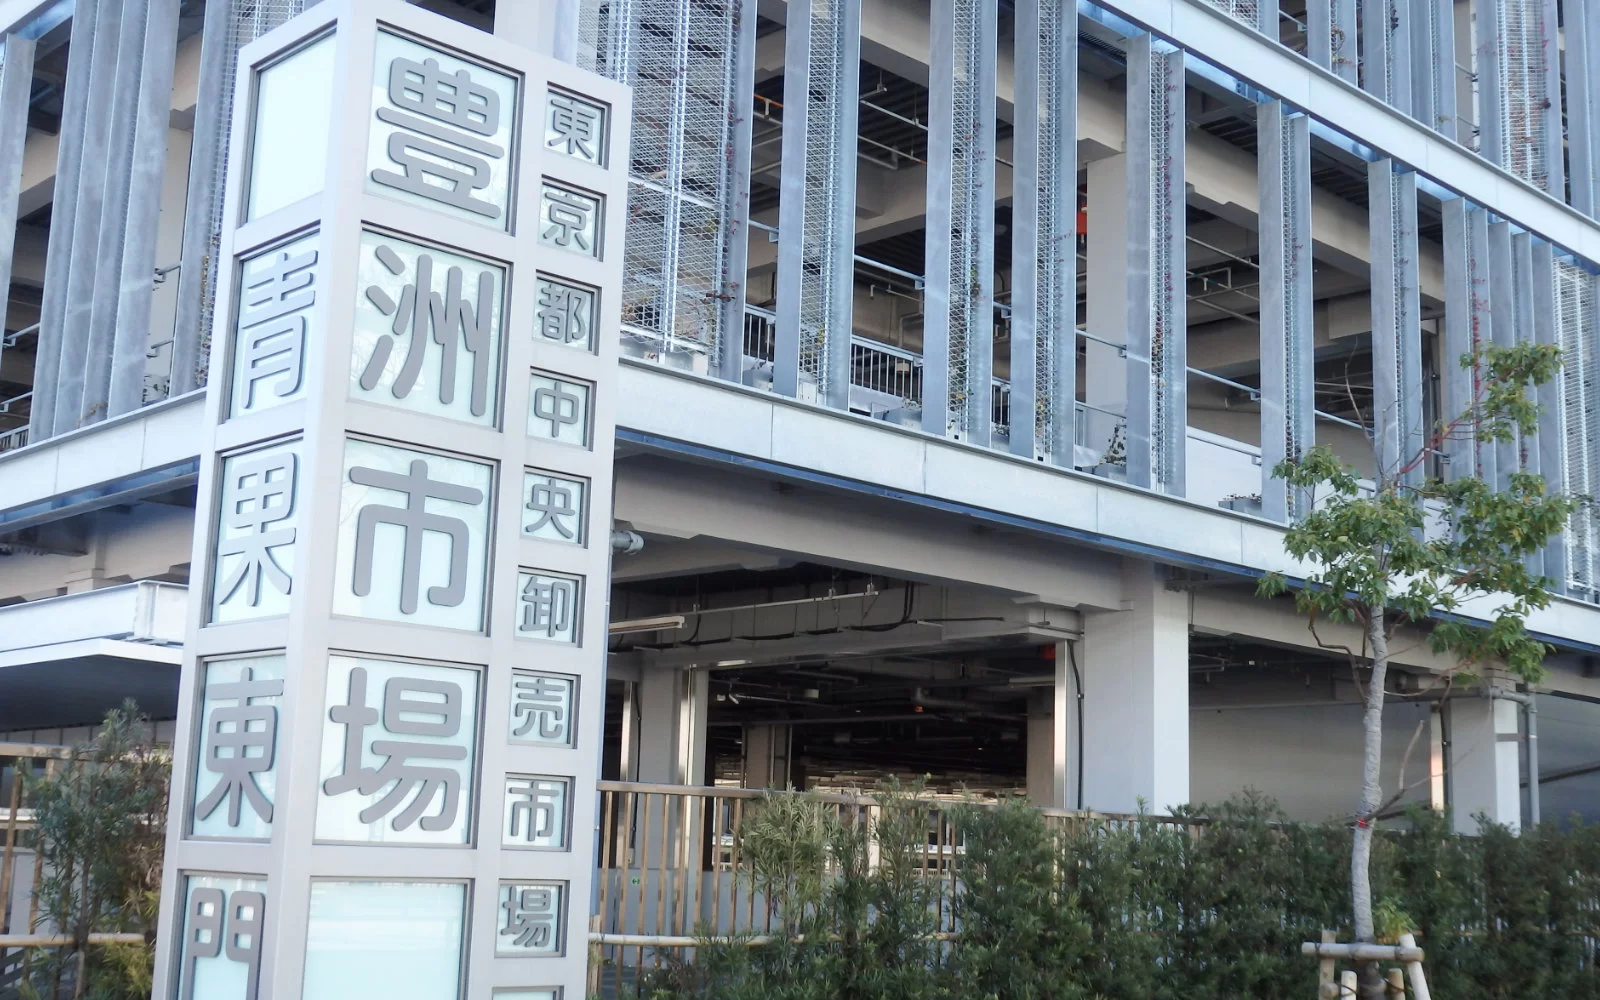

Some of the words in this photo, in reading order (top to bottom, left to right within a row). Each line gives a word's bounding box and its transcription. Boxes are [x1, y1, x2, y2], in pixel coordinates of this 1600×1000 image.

[182, 249, 319, 1000] 青果東門
[323, 57, 505, 832] 豊洲市場
[500, 99, 596, 948] 東京都中央卸売市場
